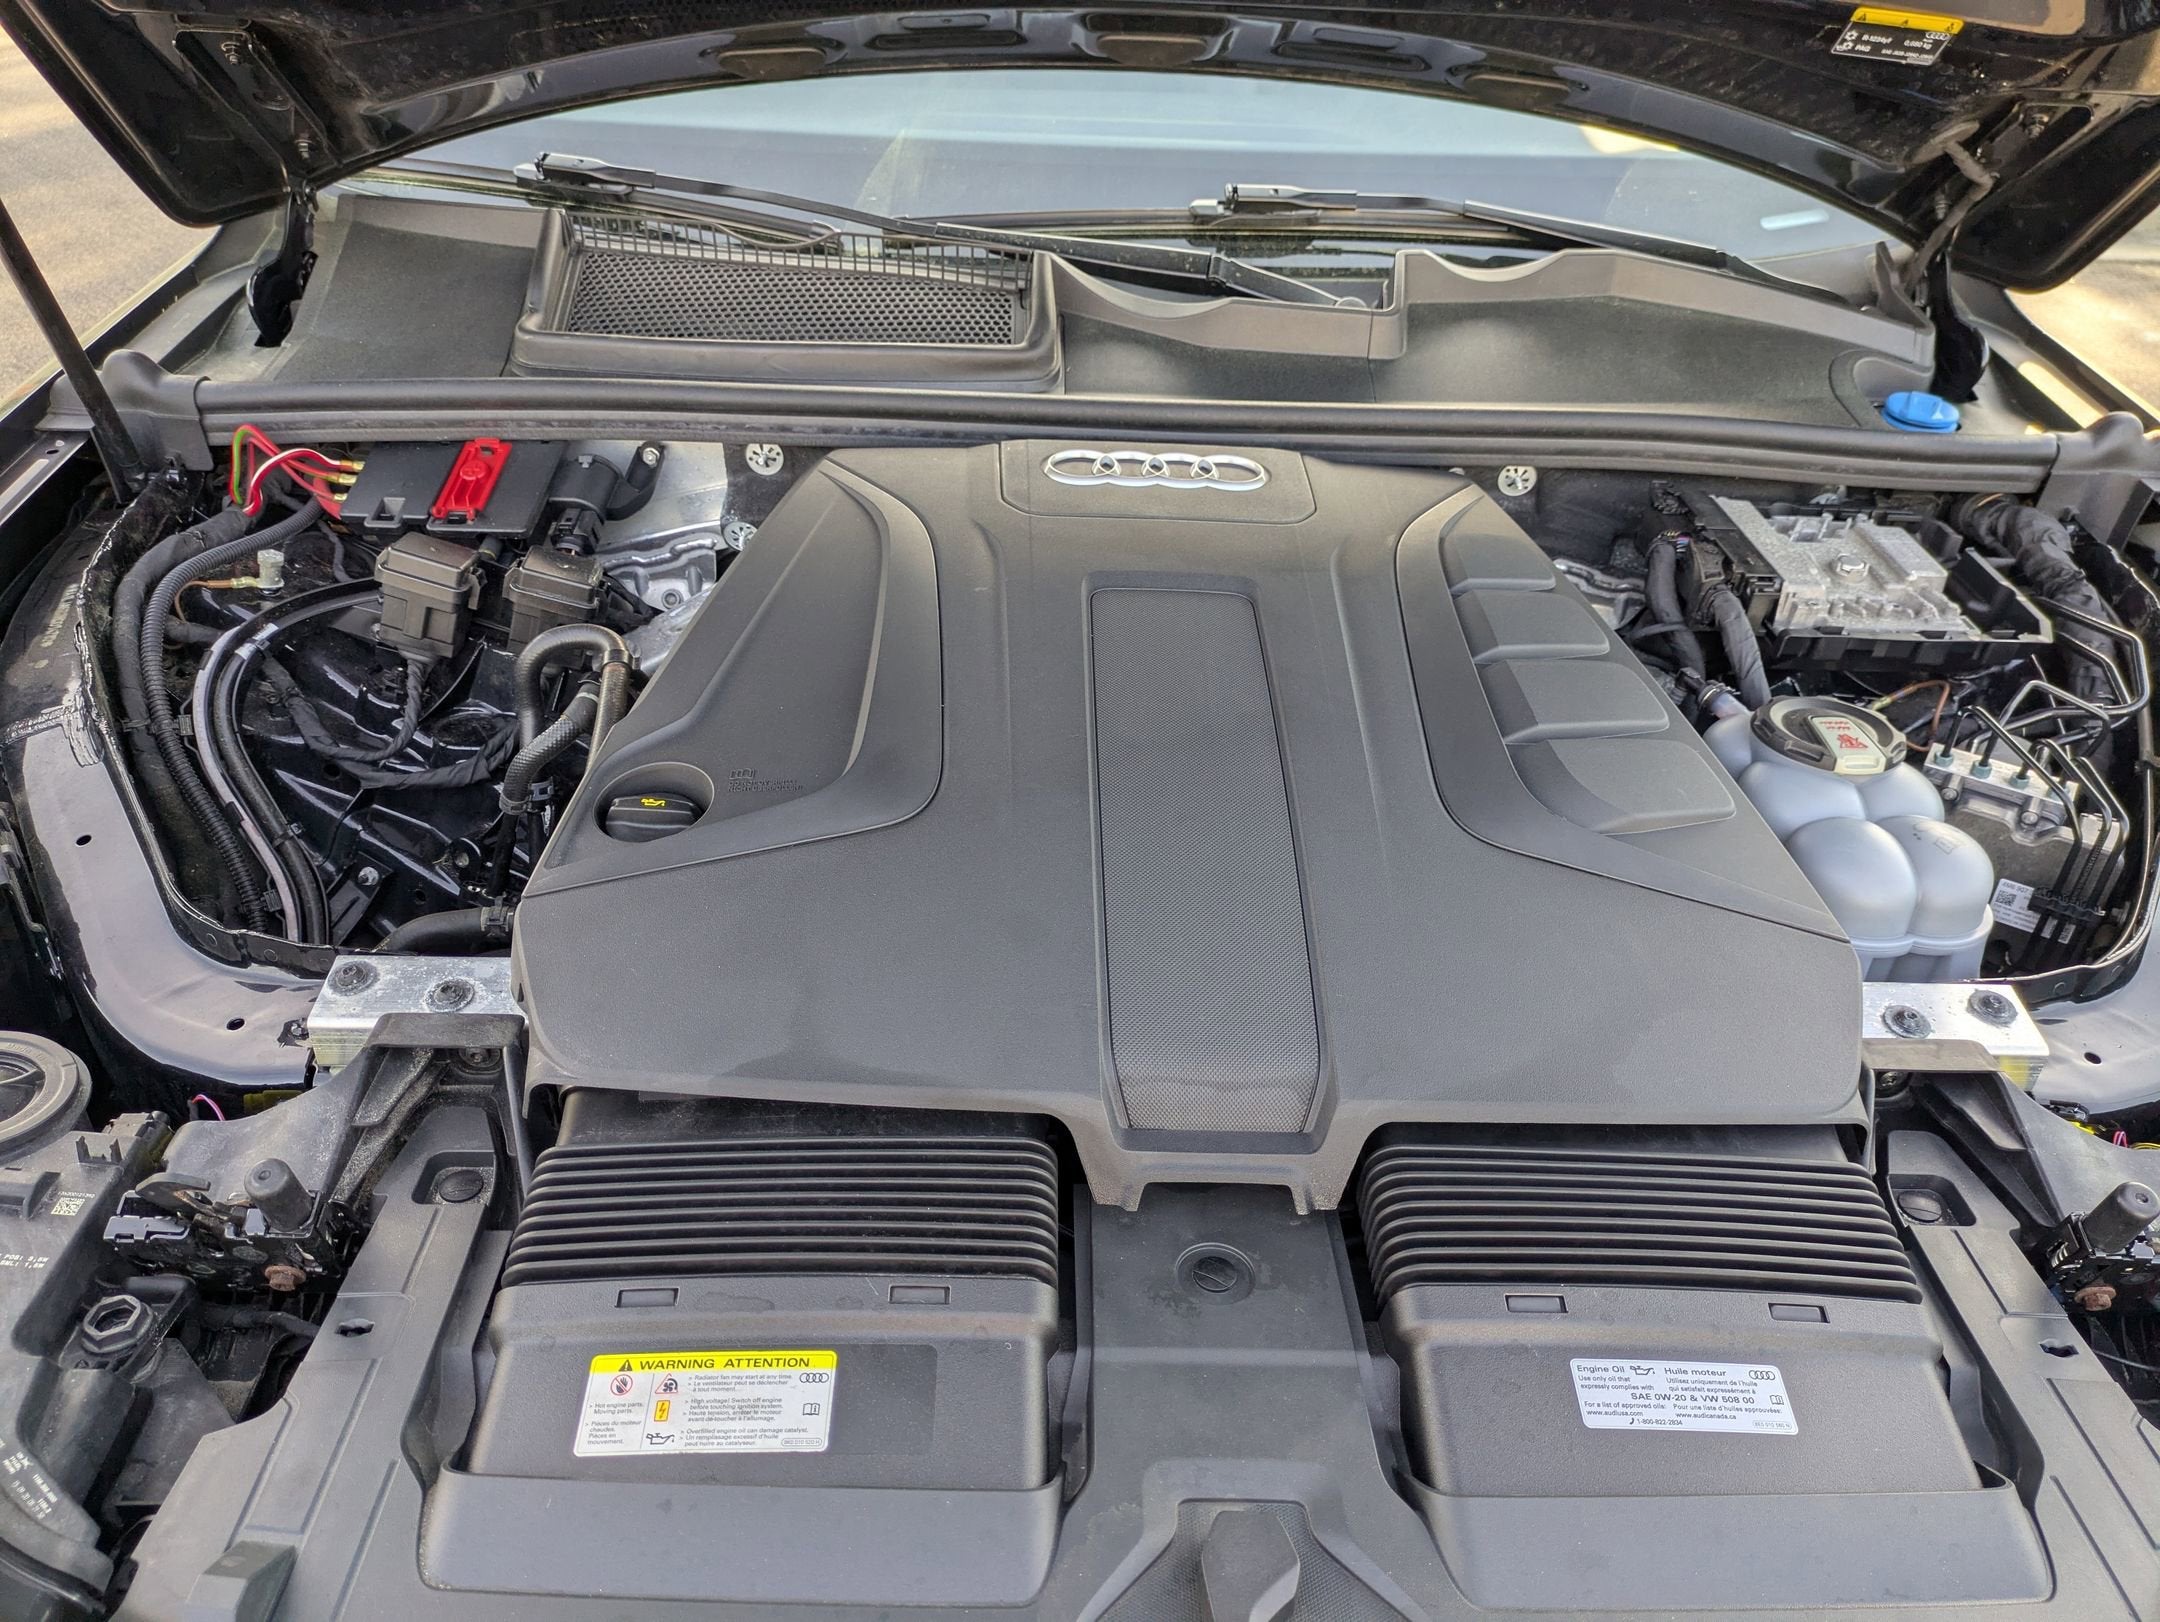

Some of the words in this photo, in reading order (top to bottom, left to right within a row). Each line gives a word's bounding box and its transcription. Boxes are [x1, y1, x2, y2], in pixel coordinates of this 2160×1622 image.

[1855, 44, 1871, 52] PAG
[640, 1359, 715, 1370] WARNING
[724, 1358, 810, 1368] ATTENTION
[1577, 1365, 1609, 1373] Engine
[1691, 1378, 1728, 1386] uniquement
[1722, 1396, 1740, 1404] 508
